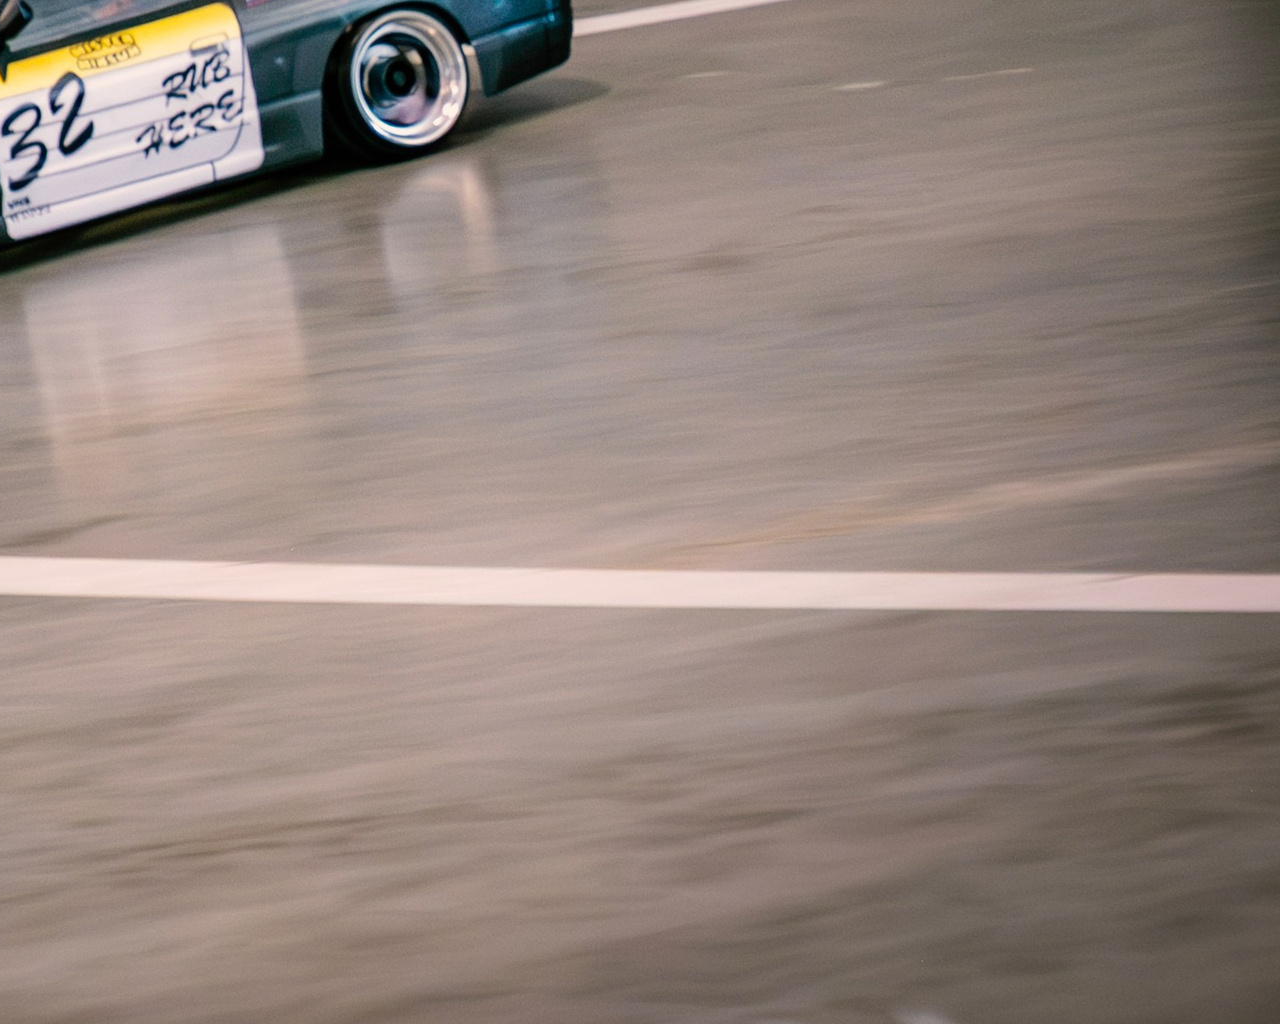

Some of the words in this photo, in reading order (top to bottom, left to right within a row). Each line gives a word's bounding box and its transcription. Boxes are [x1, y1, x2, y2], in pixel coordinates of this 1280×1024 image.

[161, 46, 232, 107] RUB
[1, 71, 95, 192] 32
[135, 88, 244, 159] HERE
